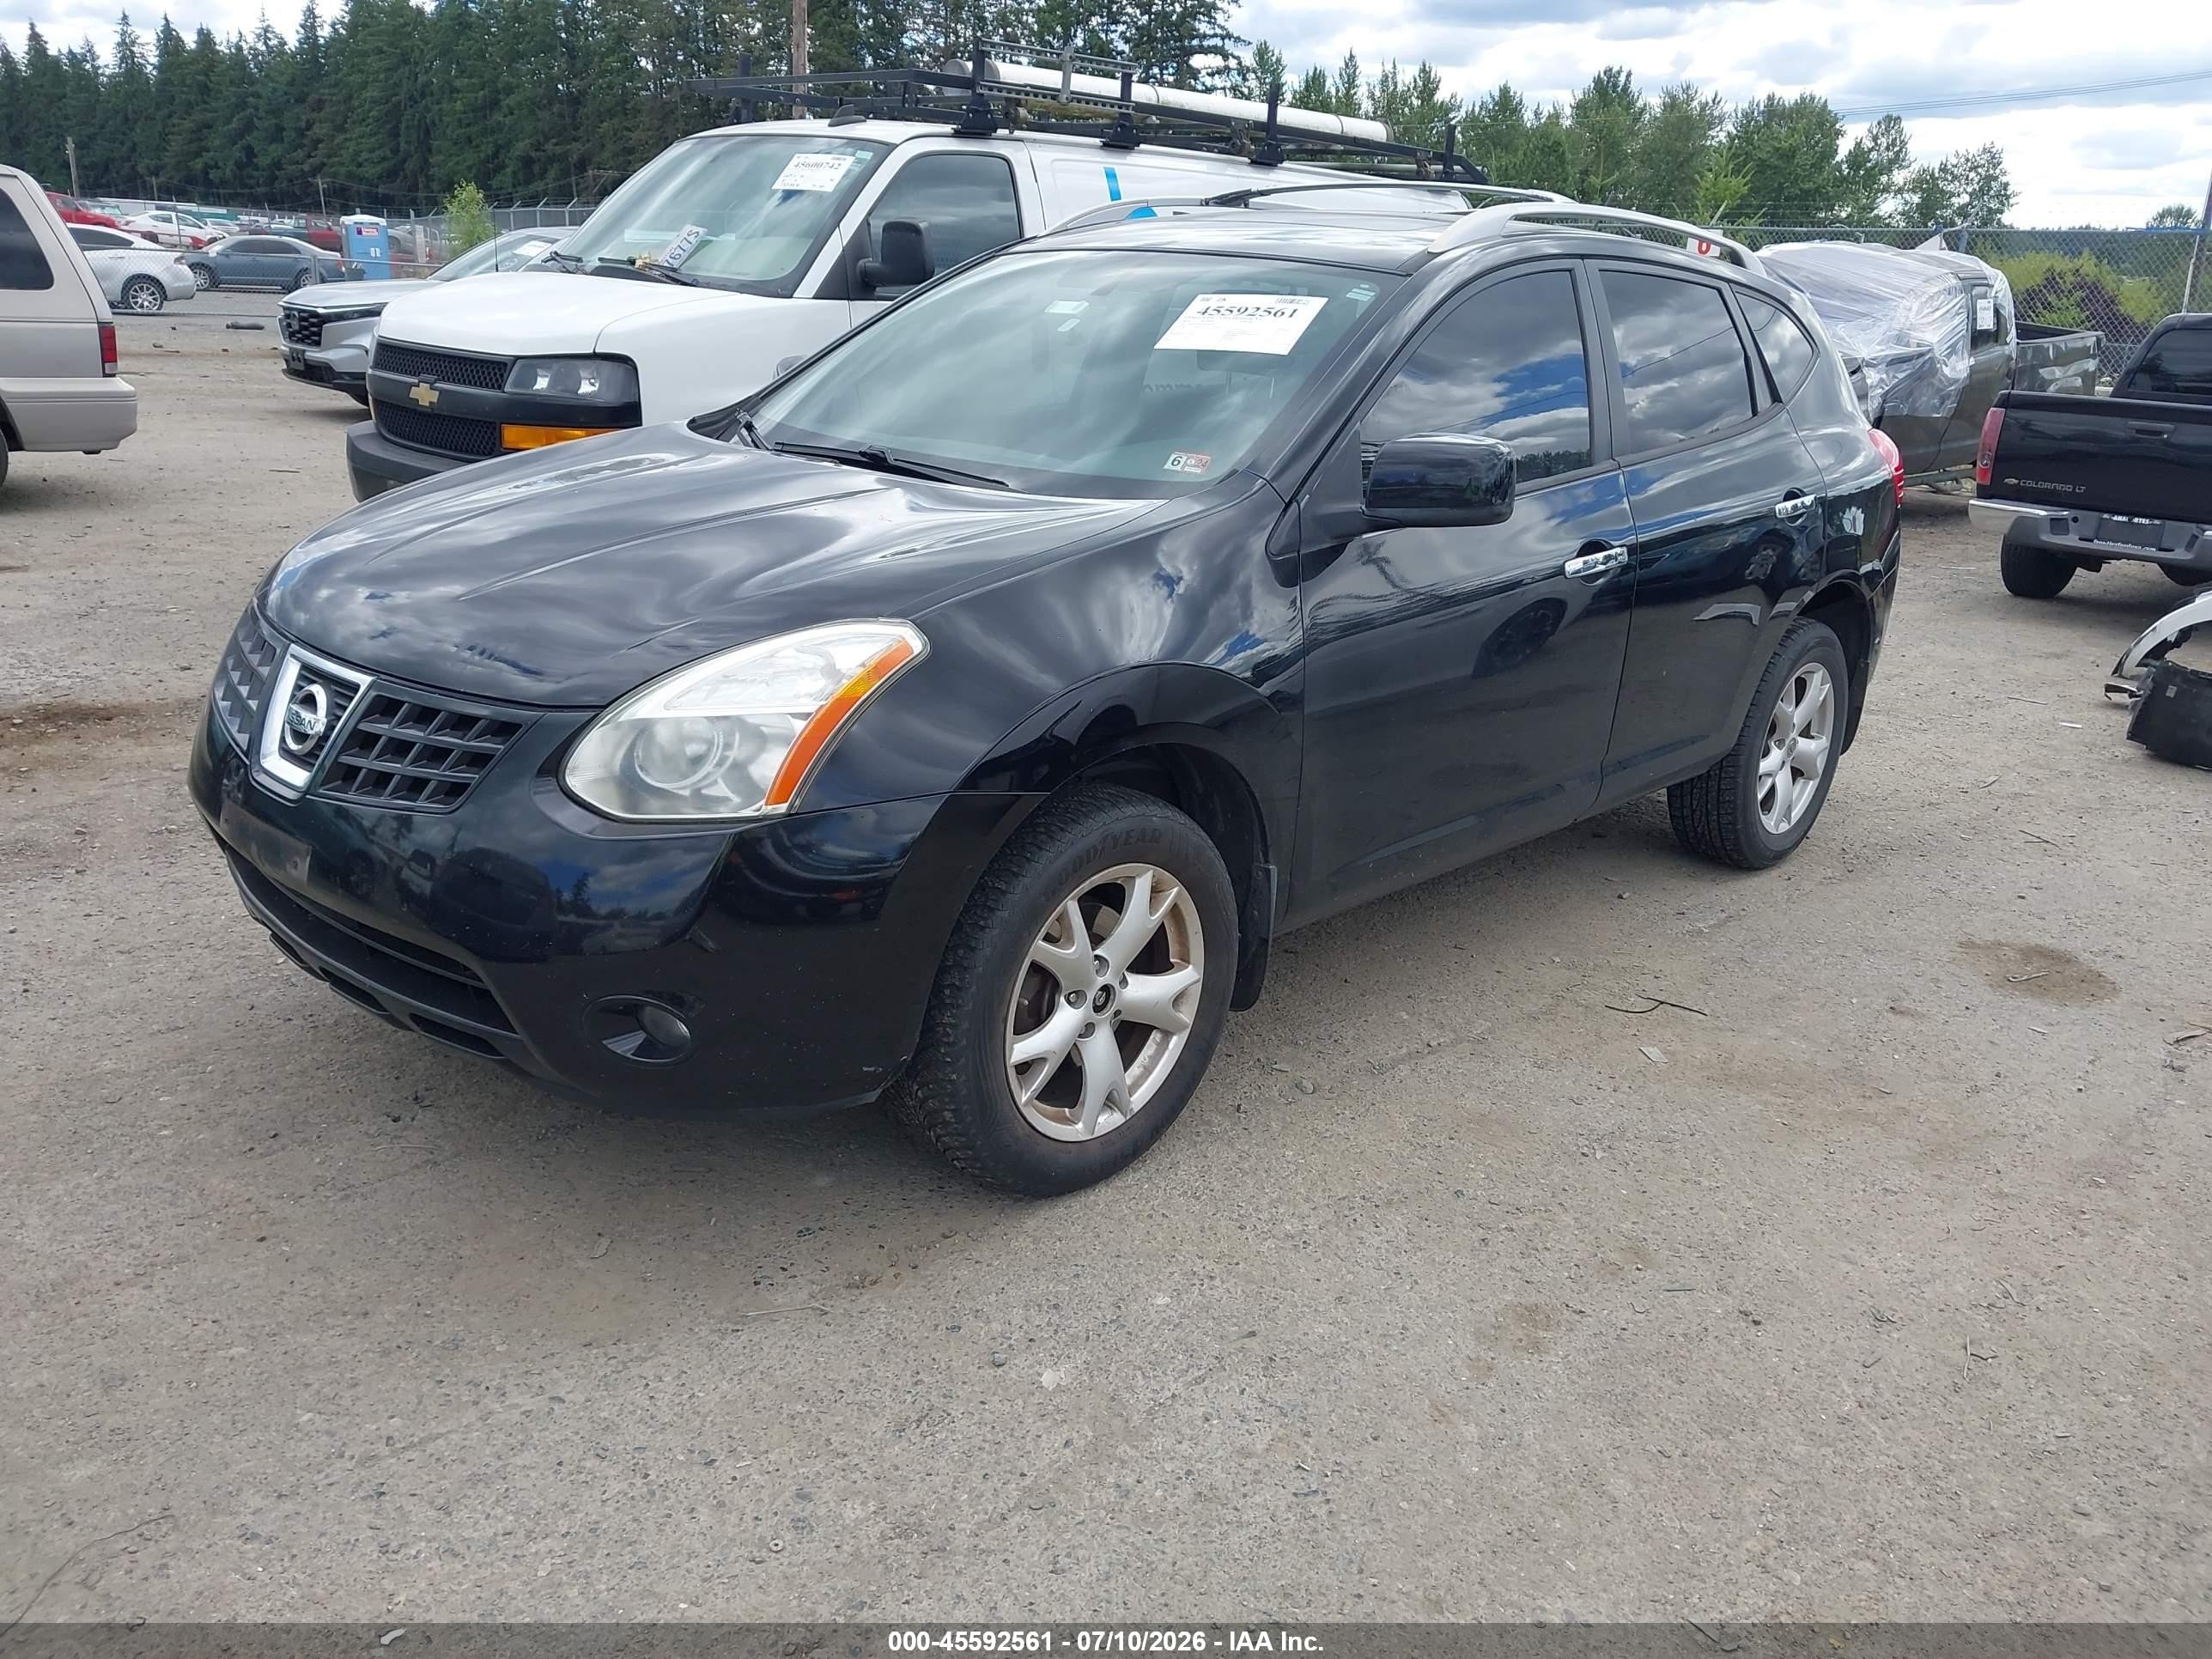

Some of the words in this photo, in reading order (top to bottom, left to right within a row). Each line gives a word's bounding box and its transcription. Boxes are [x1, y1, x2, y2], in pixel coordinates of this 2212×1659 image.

[1196, 305, 1299, 319] 45592561
[1170, 455, 1183, 466] 6
[2020, 479, 2073, 492] COLORADO
